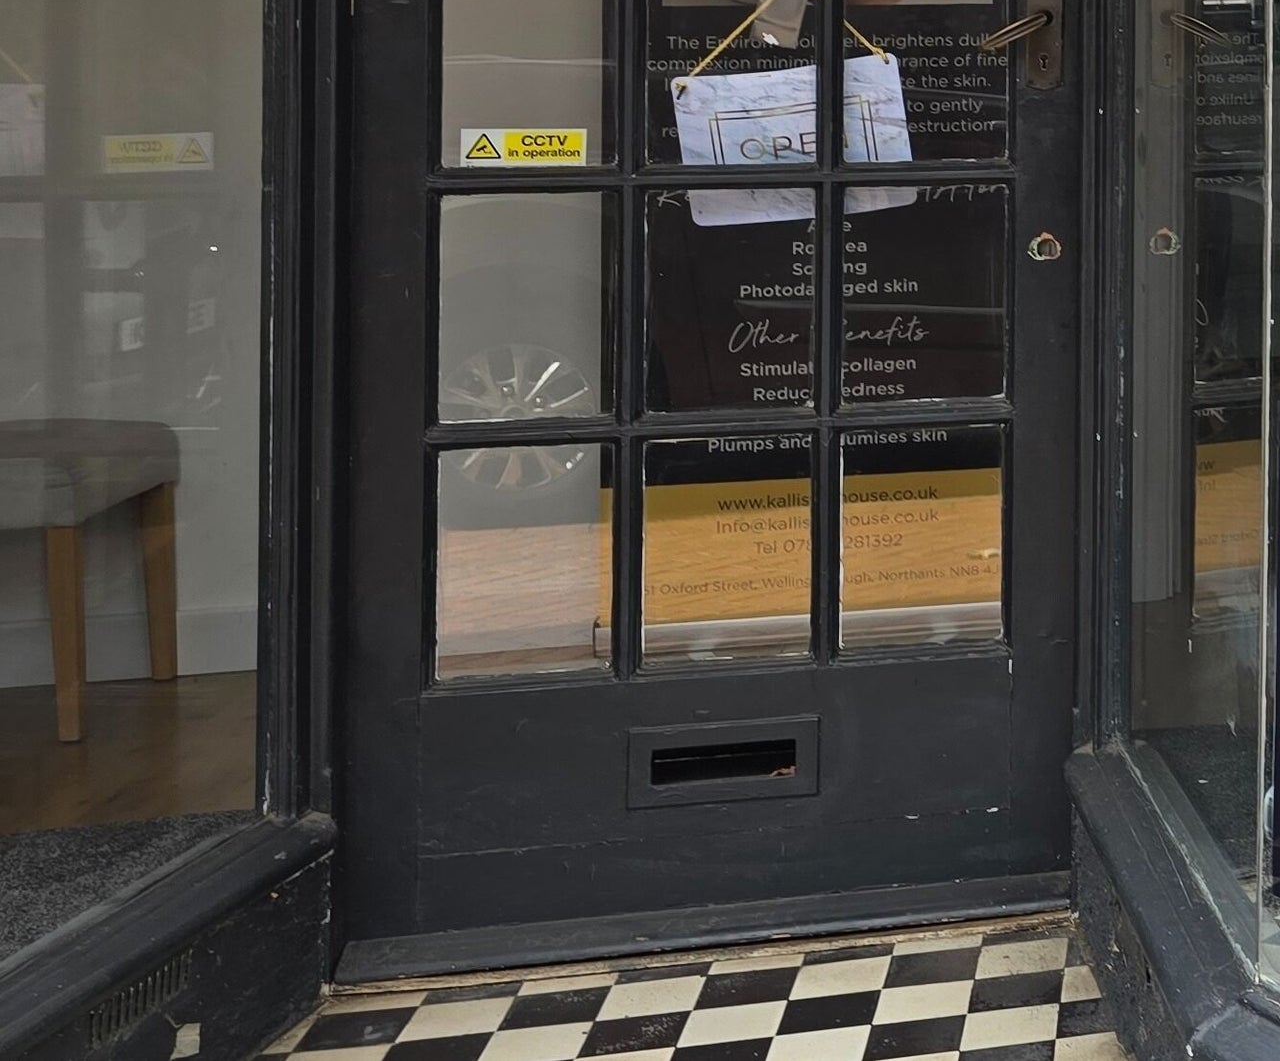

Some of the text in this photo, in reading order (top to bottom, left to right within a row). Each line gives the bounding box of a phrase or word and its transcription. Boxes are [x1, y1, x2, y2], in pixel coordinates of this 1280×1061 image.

[872, 33, 953, 49] brightens
[929, 98, 983, 114] gently
[522, 136, 568, 146] CCTV
[523, 149, 580, 158] operation
[728, 319, 799, 353] Other
